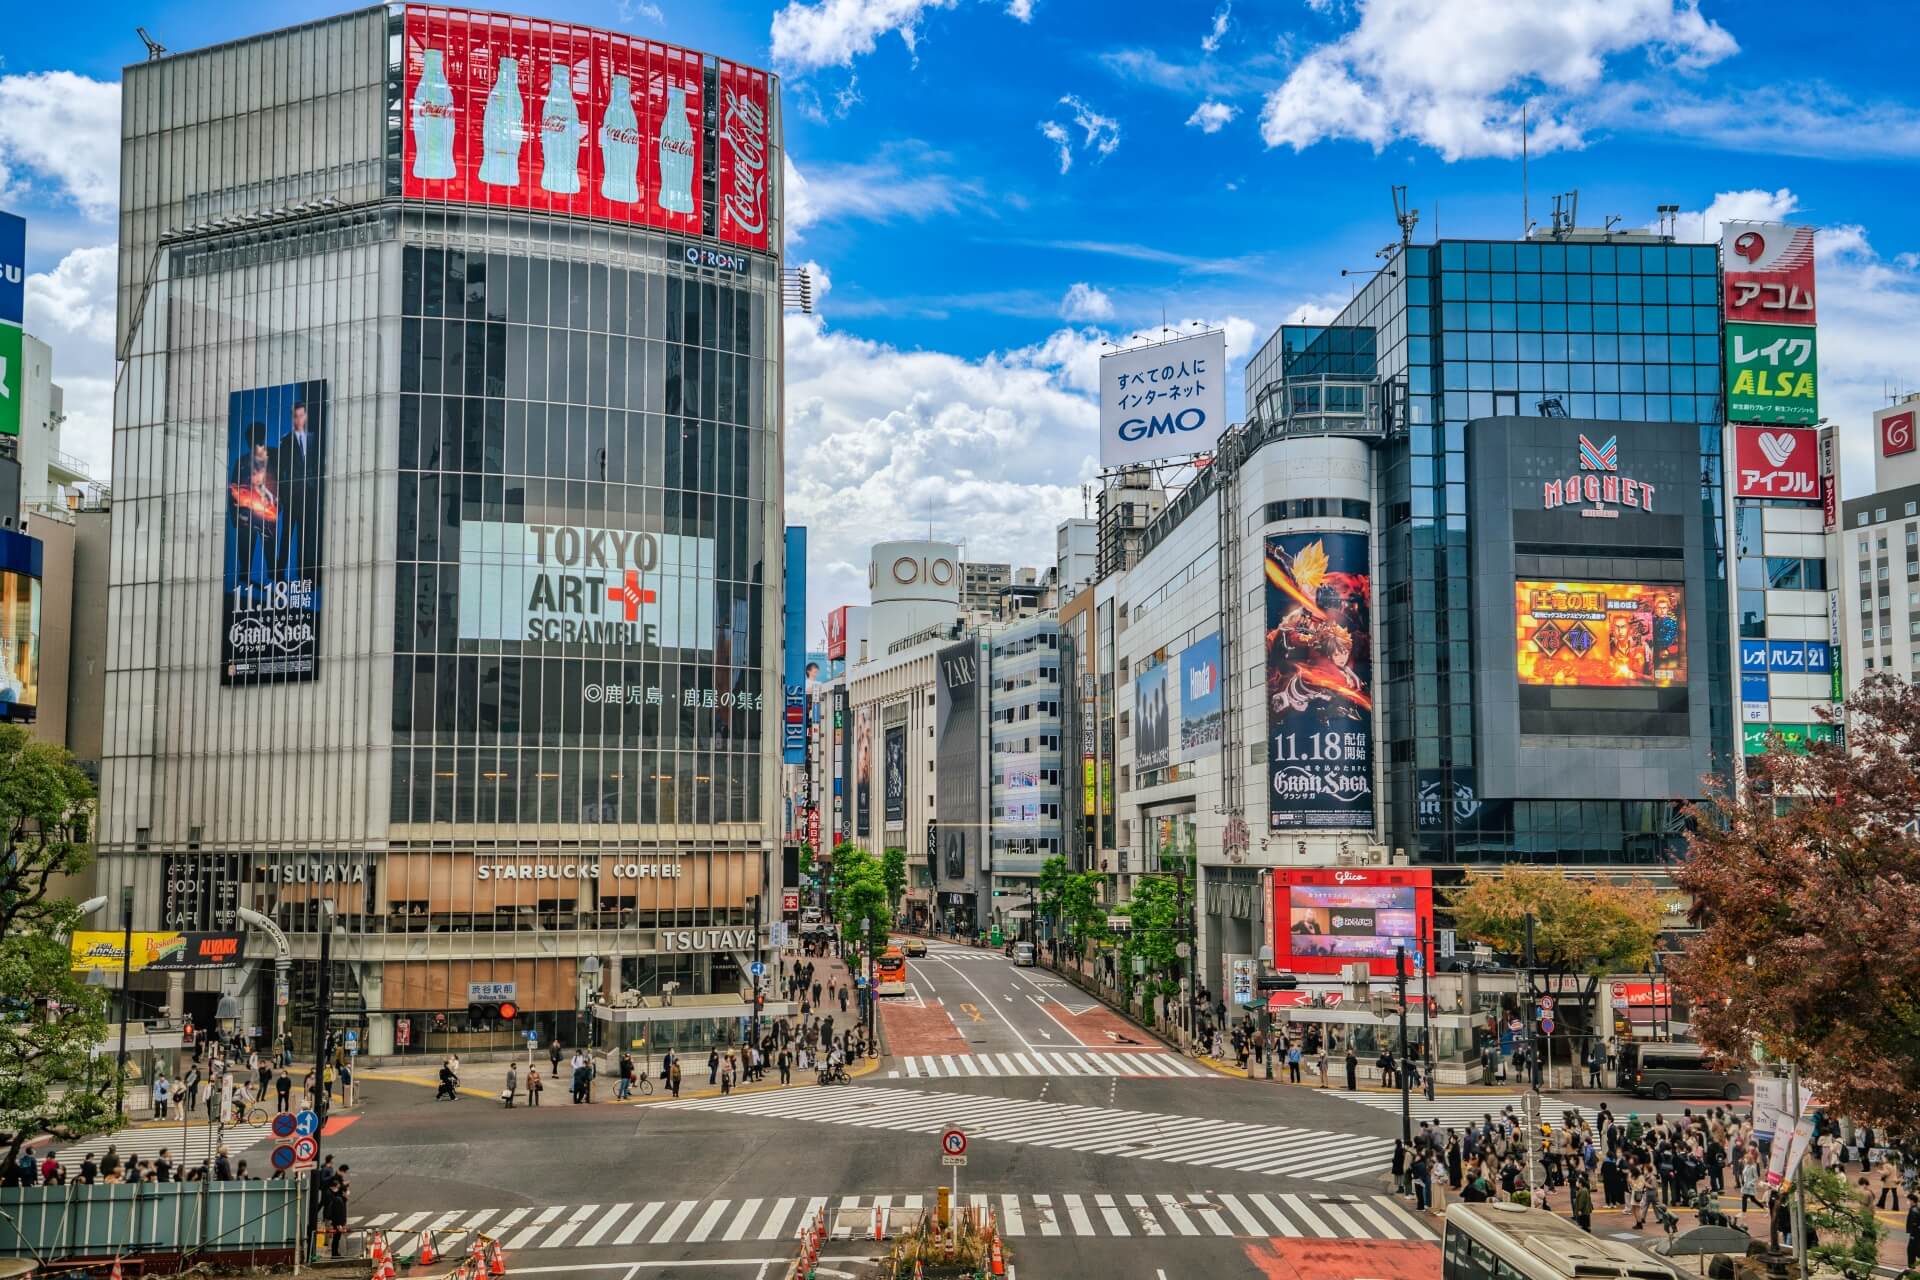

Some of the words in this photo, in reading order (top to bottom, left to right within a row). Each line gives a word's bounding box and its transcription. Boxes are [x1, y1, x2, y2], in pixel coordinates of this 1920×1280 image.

[1733, 281, 1815, 311] アコム
[1734, 336, 1812, 368] レイク
[1118, 360, 1205, 390] すべての人に
[1732, 369, 1815, 398] ALSA
[1118, 381, 1205, 410] インターネット
[1118, 408, 1206, 442] GMO
[1544, 474, 1656, 512] MAGNET
[1741, 469, 1815, 494] アイフル
[529, 525, 659, 571] TOKYO
[232, 581, 288, 613] 11.18
[528, 573, 608, 614] ART
[528, 617, 657, 647] SCRAMBLE
[1539, 631, 1561, 650] 73
[1570, 630, 1593, 650] 74
[787, 685, 805, 749] SEIBU
[1750, 711, 1761, 719] 6F
[1275, 732, 1342, 761] 11.18
[1343, 733, 1366, 746] 配信
[1343, 747, 1366, 760] 開始
[269, 864, 364, 882] TSUTAYA
[478, 864, 600, 880] STARBUCKS
[613, 864, 681, 879] COFFEE
[1335, 871, 1367, 884] Glico
[785, 897, 798, 908] 本
[662, 930, 756, 951] TSUTAYA
[472, 985, 513, 994] 渋谷駅前
